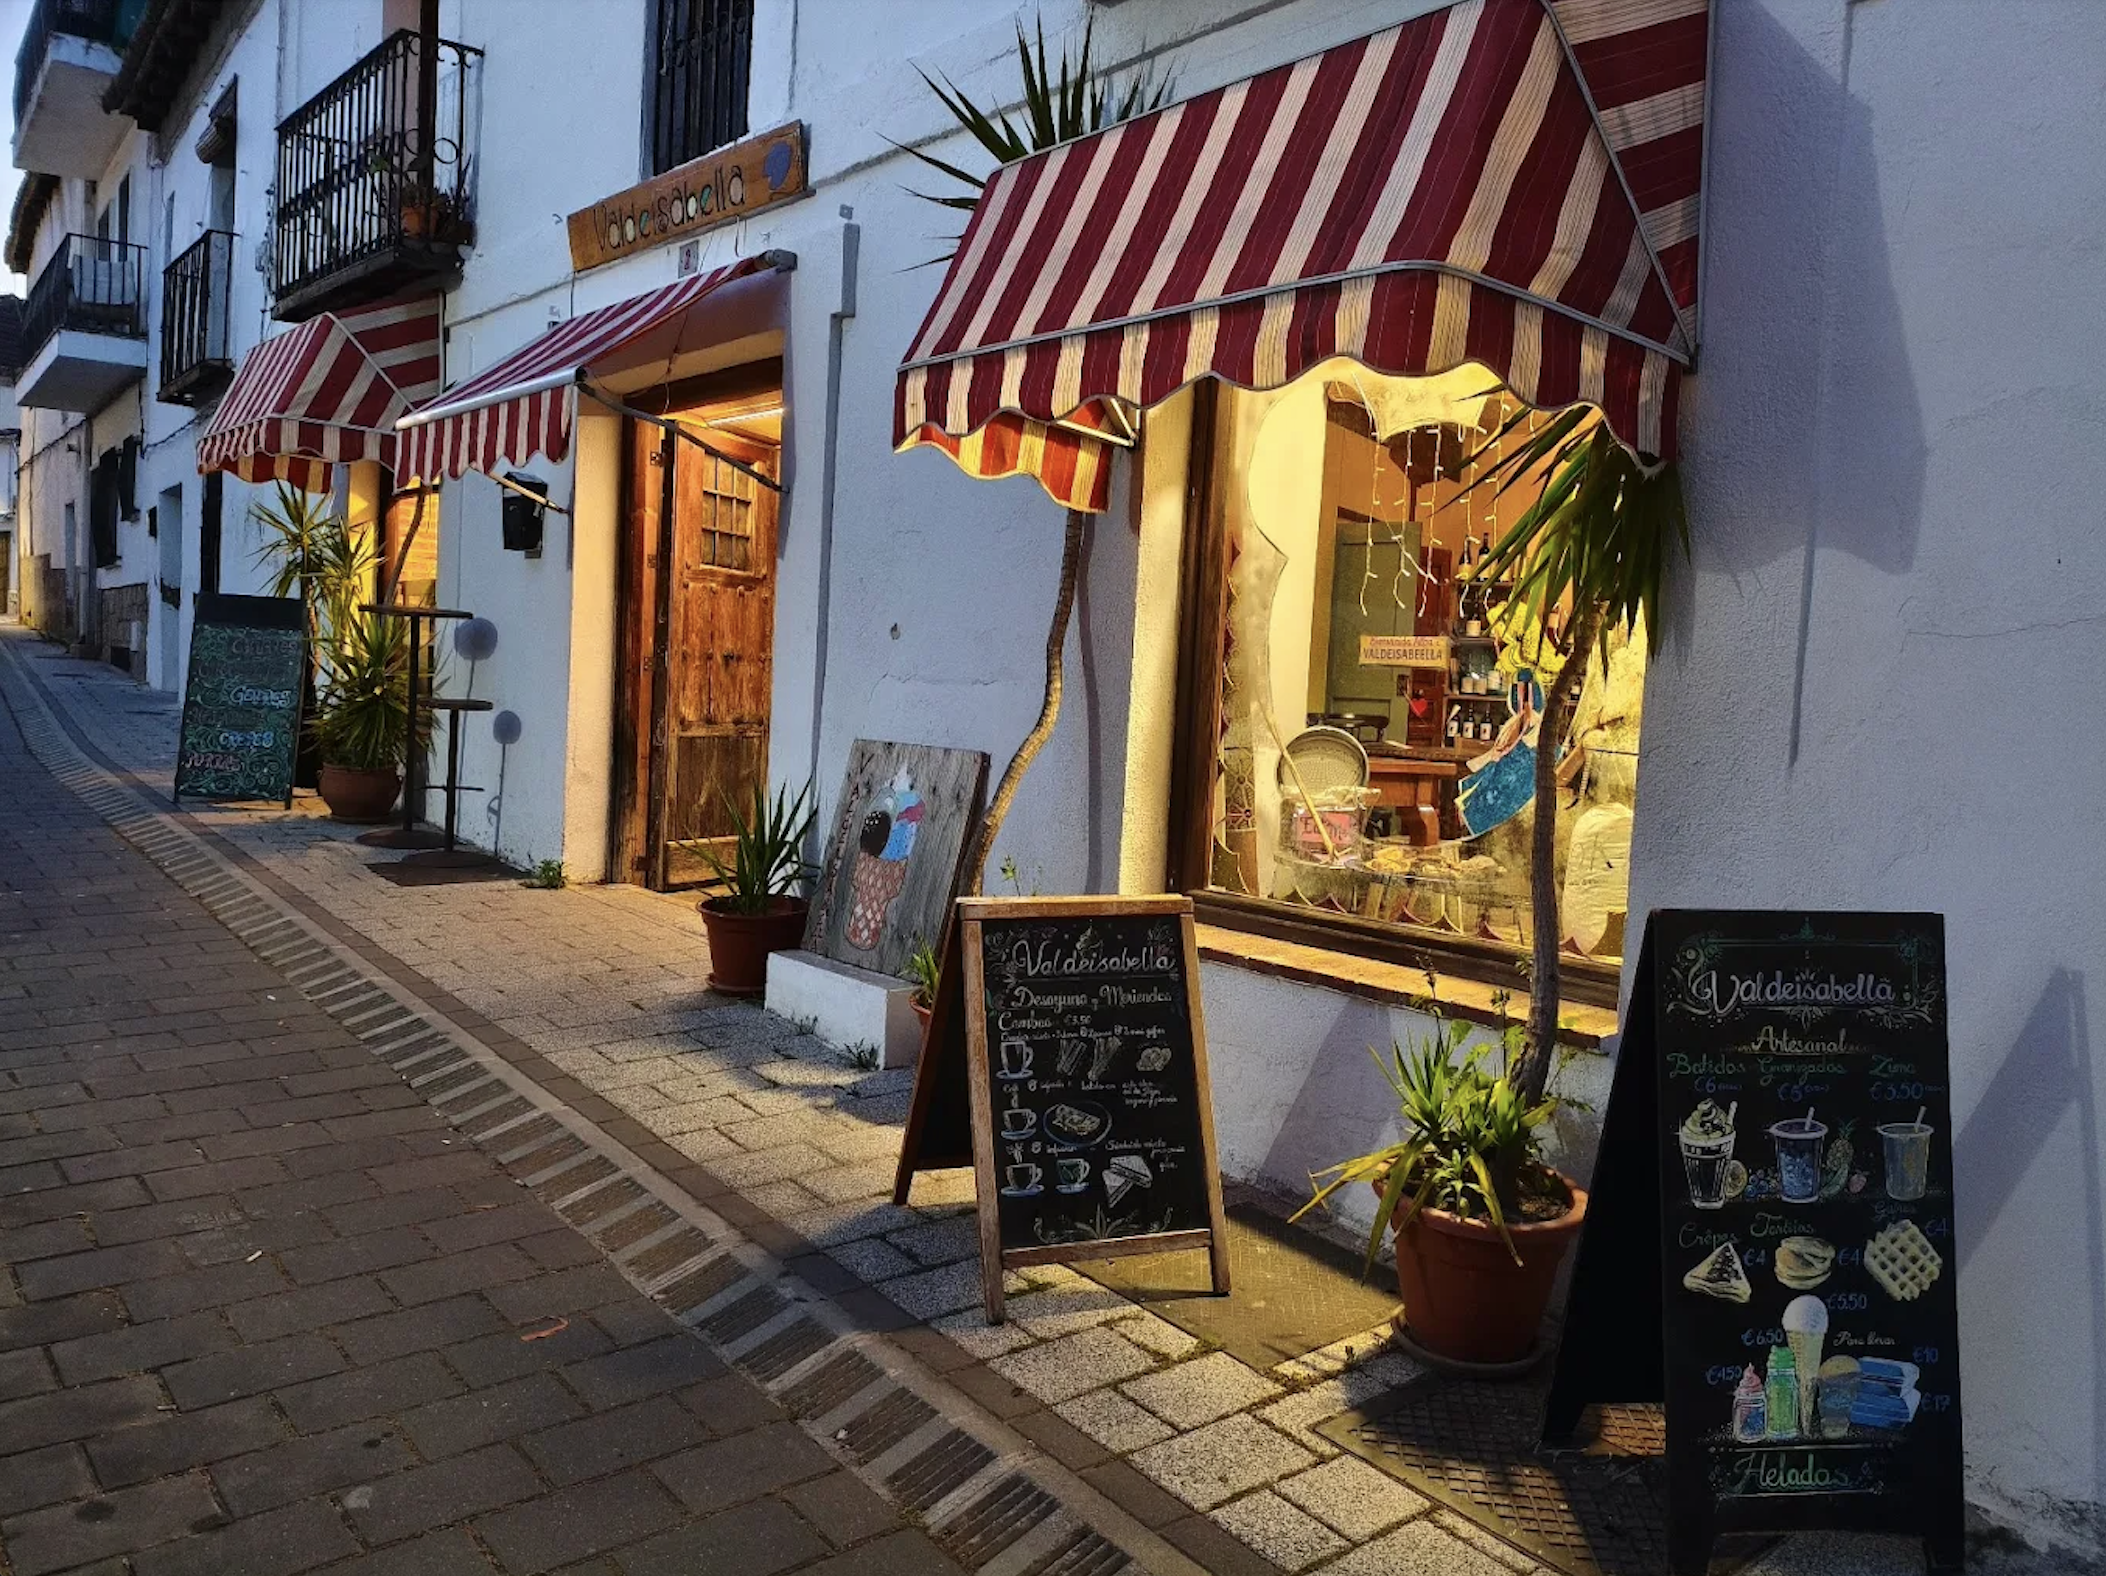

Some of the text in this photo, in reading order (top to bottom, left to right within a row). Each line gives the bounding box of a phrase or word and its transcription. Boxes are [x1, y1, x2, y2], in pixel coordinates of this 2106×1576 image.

[593, 165, 746, 251] Valdeisabella
[1012, 940, 1176, 977] Valdeisabella
[1011, 985, 1087, 1013] Desayuno
[1691, 970, 1896, 1015] Valdeisabella
[1730, 1452, 1850, 1490] Helados
